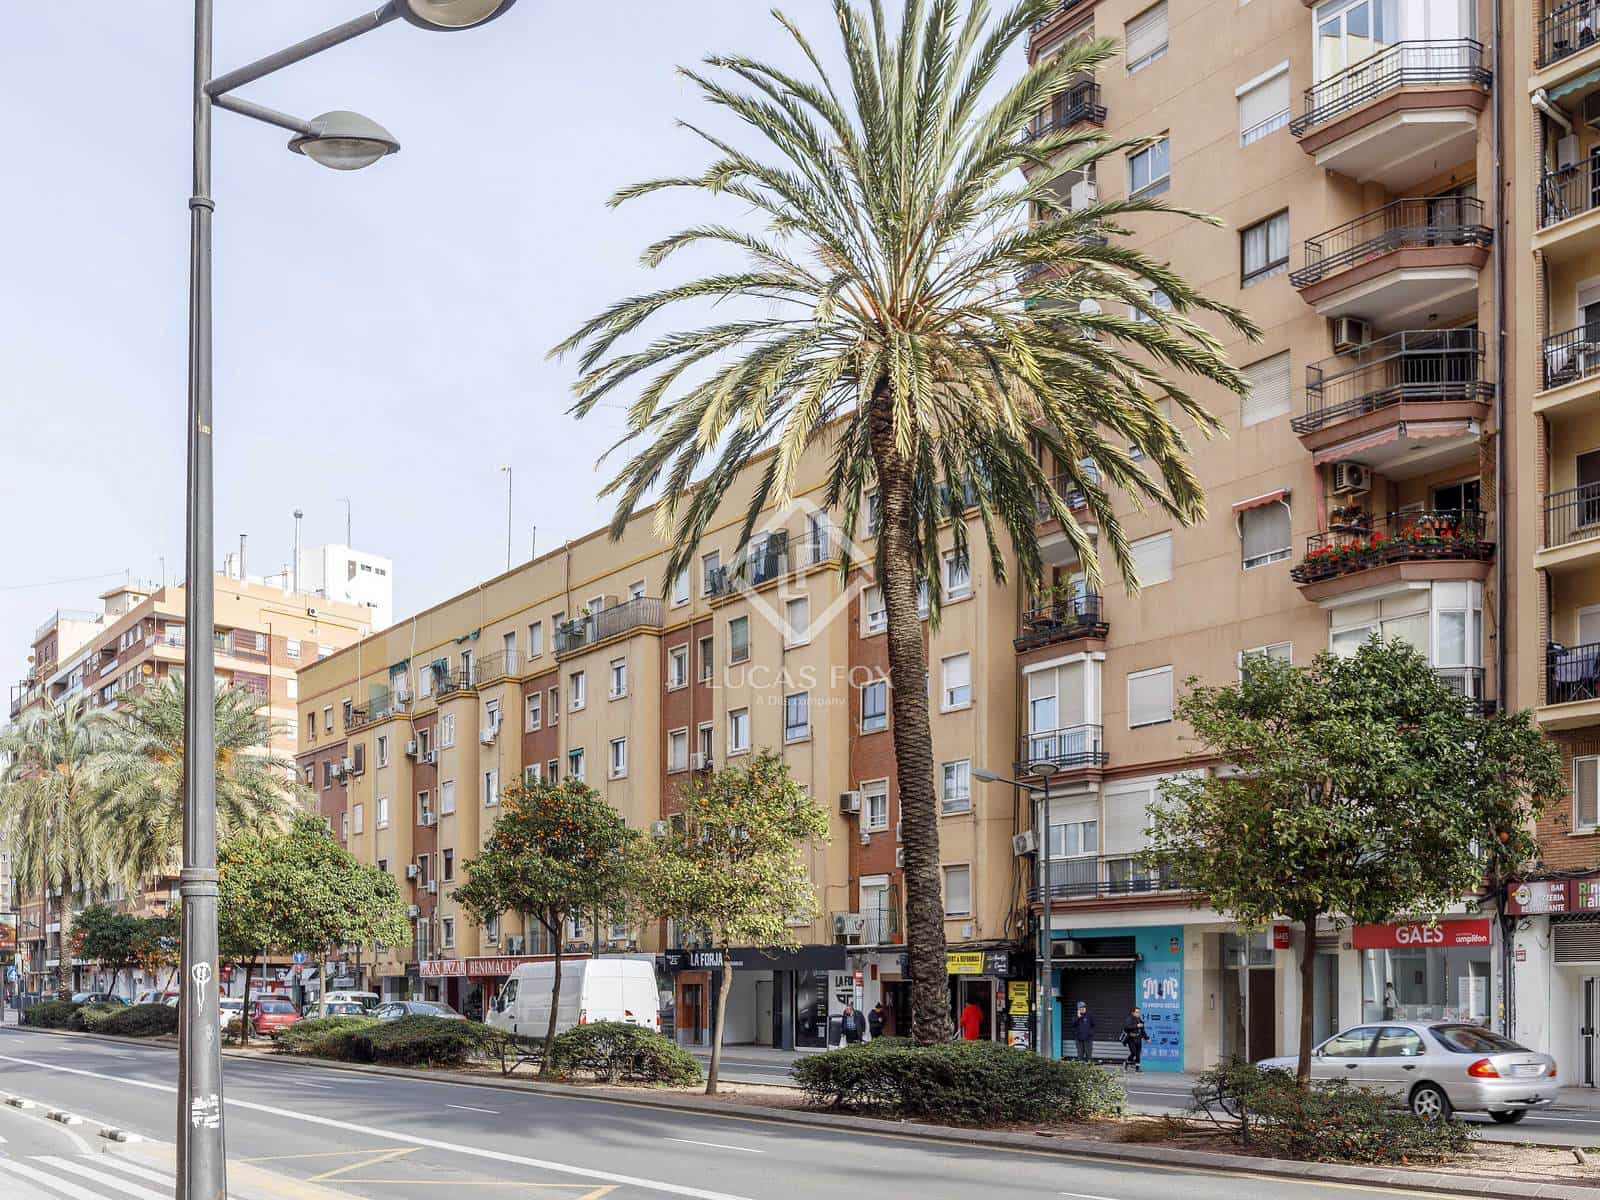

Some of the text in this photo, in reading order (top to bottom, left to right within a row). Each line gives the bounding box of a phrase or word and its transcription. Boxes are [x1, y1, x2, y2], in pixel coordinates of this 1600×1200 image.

[1395, 926, 1444, 944] GAES
[1455, 933, 1487, 945] amplifon
[690, 952, 699, 966] LA
[700, 952, 723, 966] FORJA
[835, 975, 844, 987] LA
